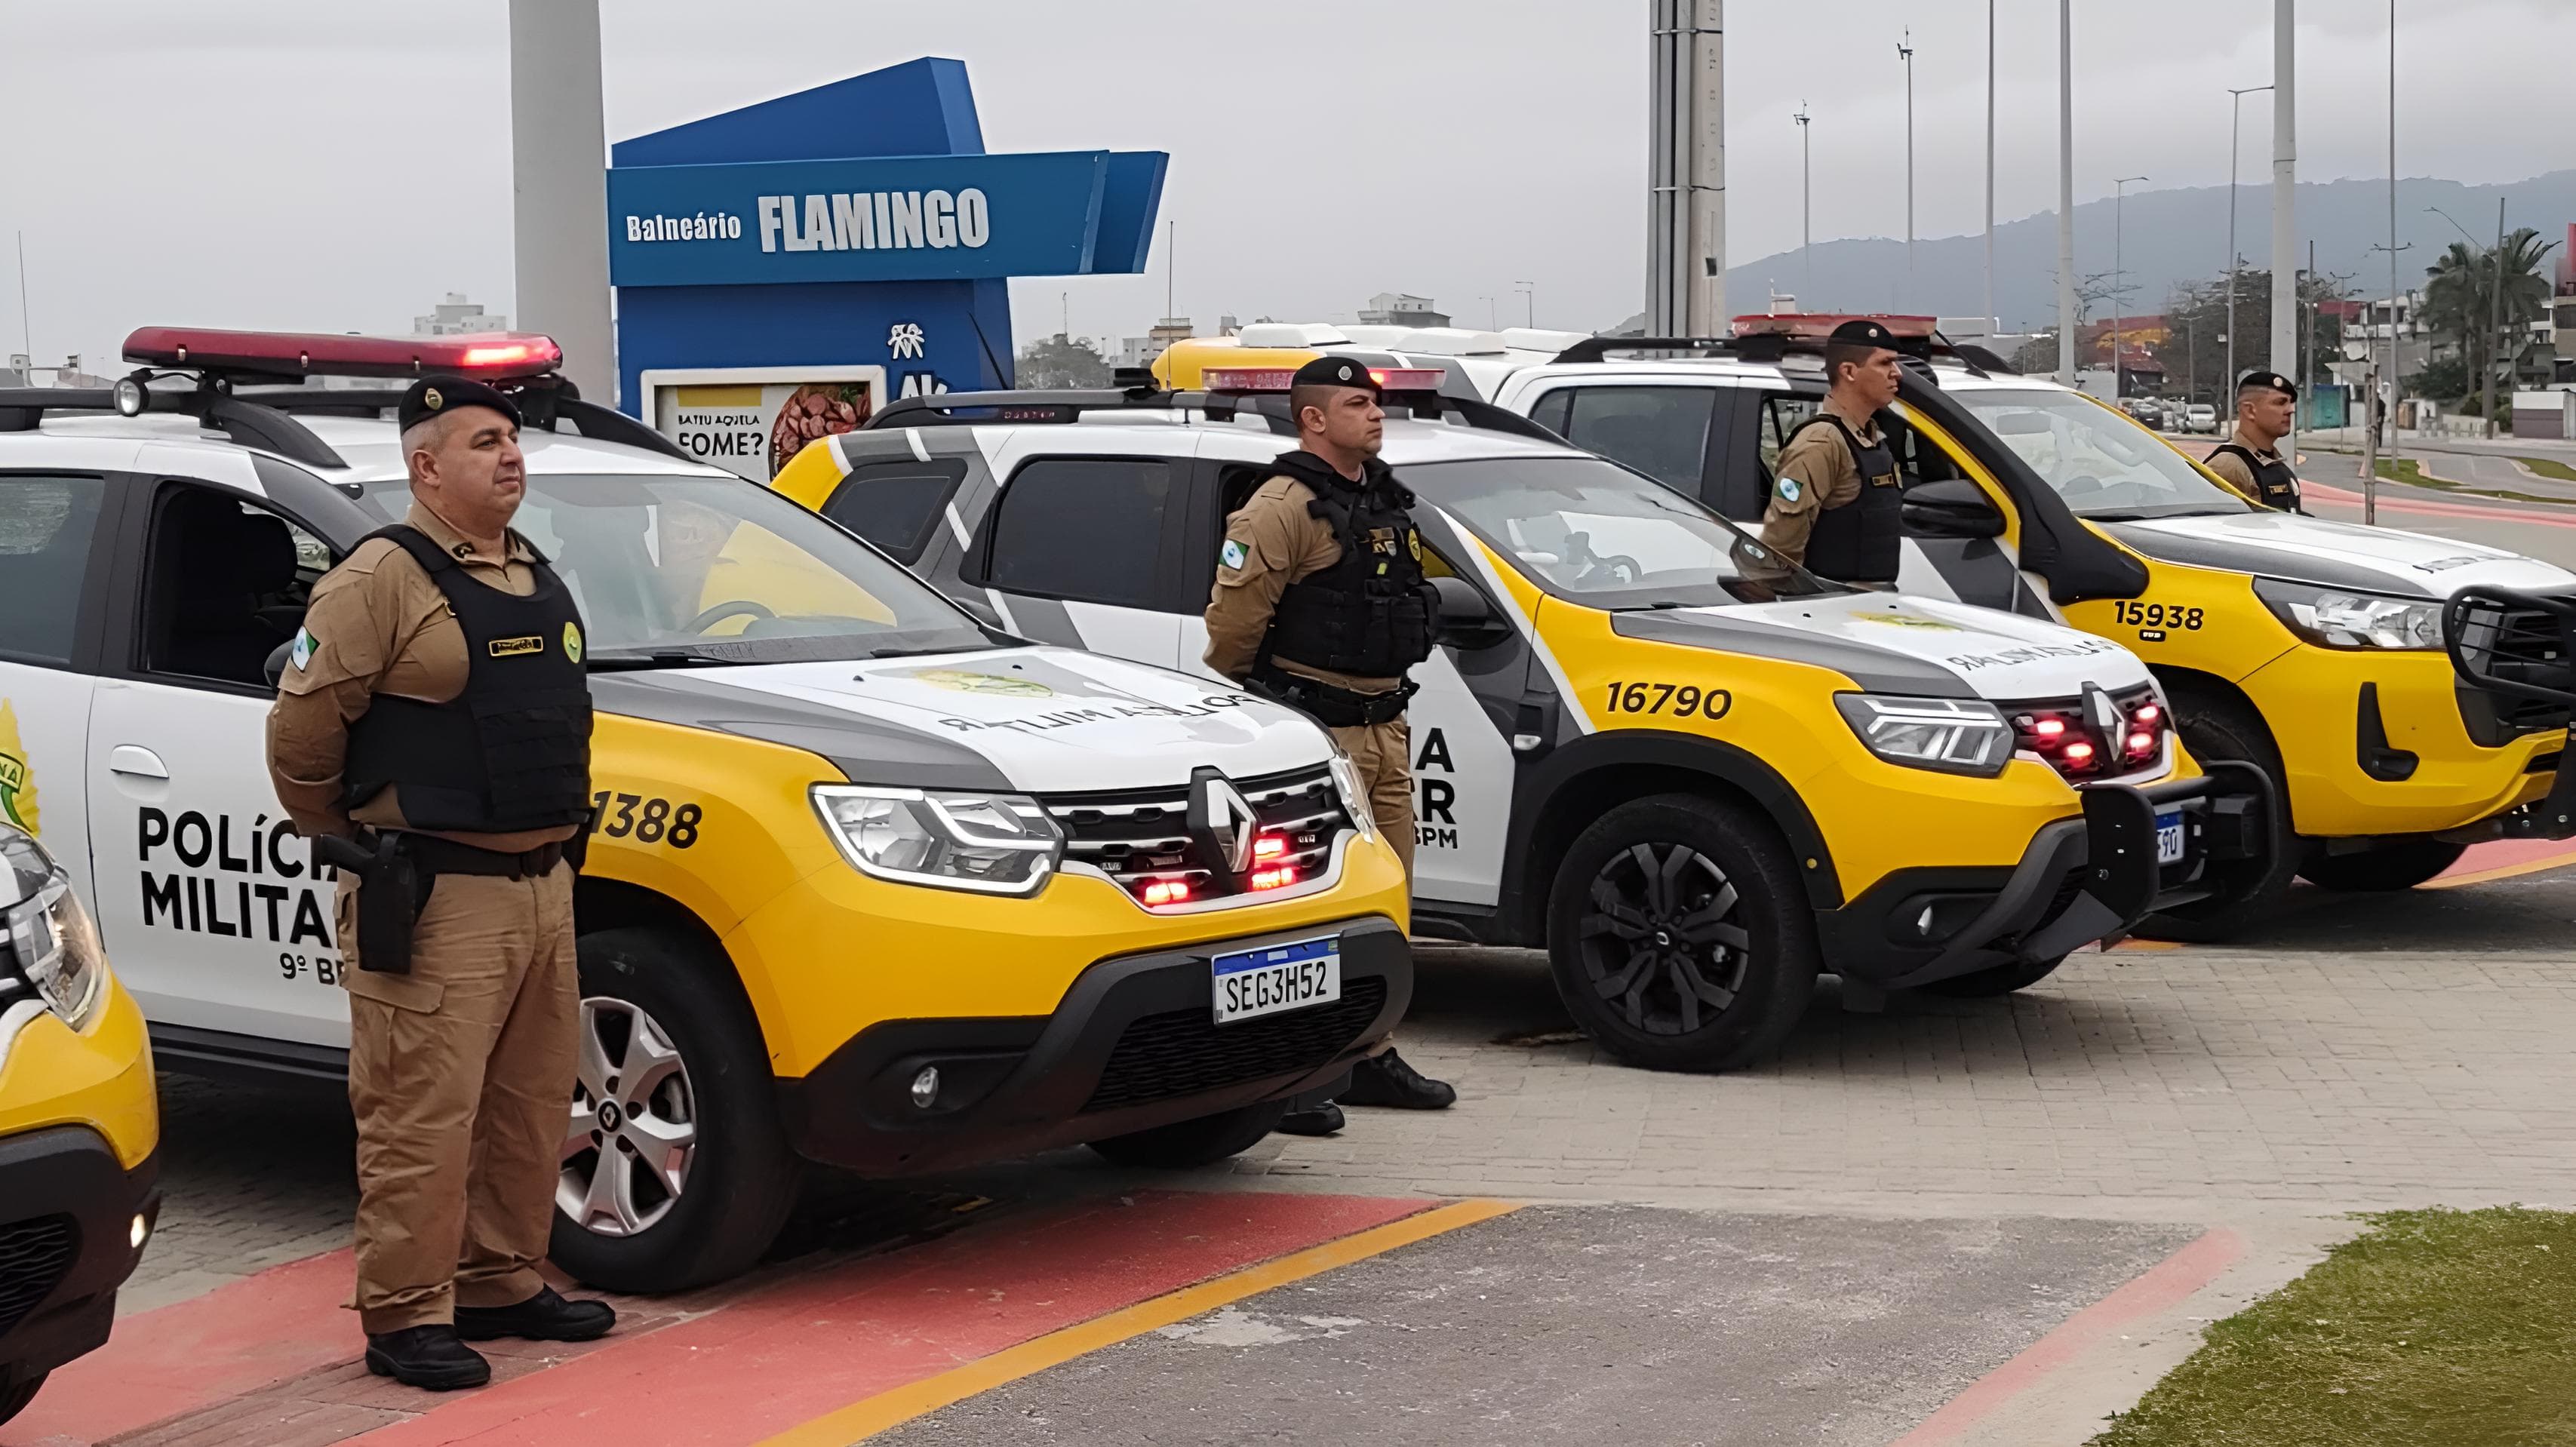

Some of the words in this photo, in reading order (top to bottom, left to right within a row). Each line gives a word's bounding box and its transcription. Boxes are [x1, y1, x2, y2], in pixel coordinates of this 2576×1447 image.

[626, 212, 742, 241] Balneário
[758, 188, 989, 253] FLAMINGO
[2115, 601, 2204, 631] 15938
[1607, 681, 1732, 720] 16790
[139, 806, 338, 883] POLÍCI
[141, 870, 343, 950] MILITA
[1227, 960, 1327, 1013] SEG3H52
